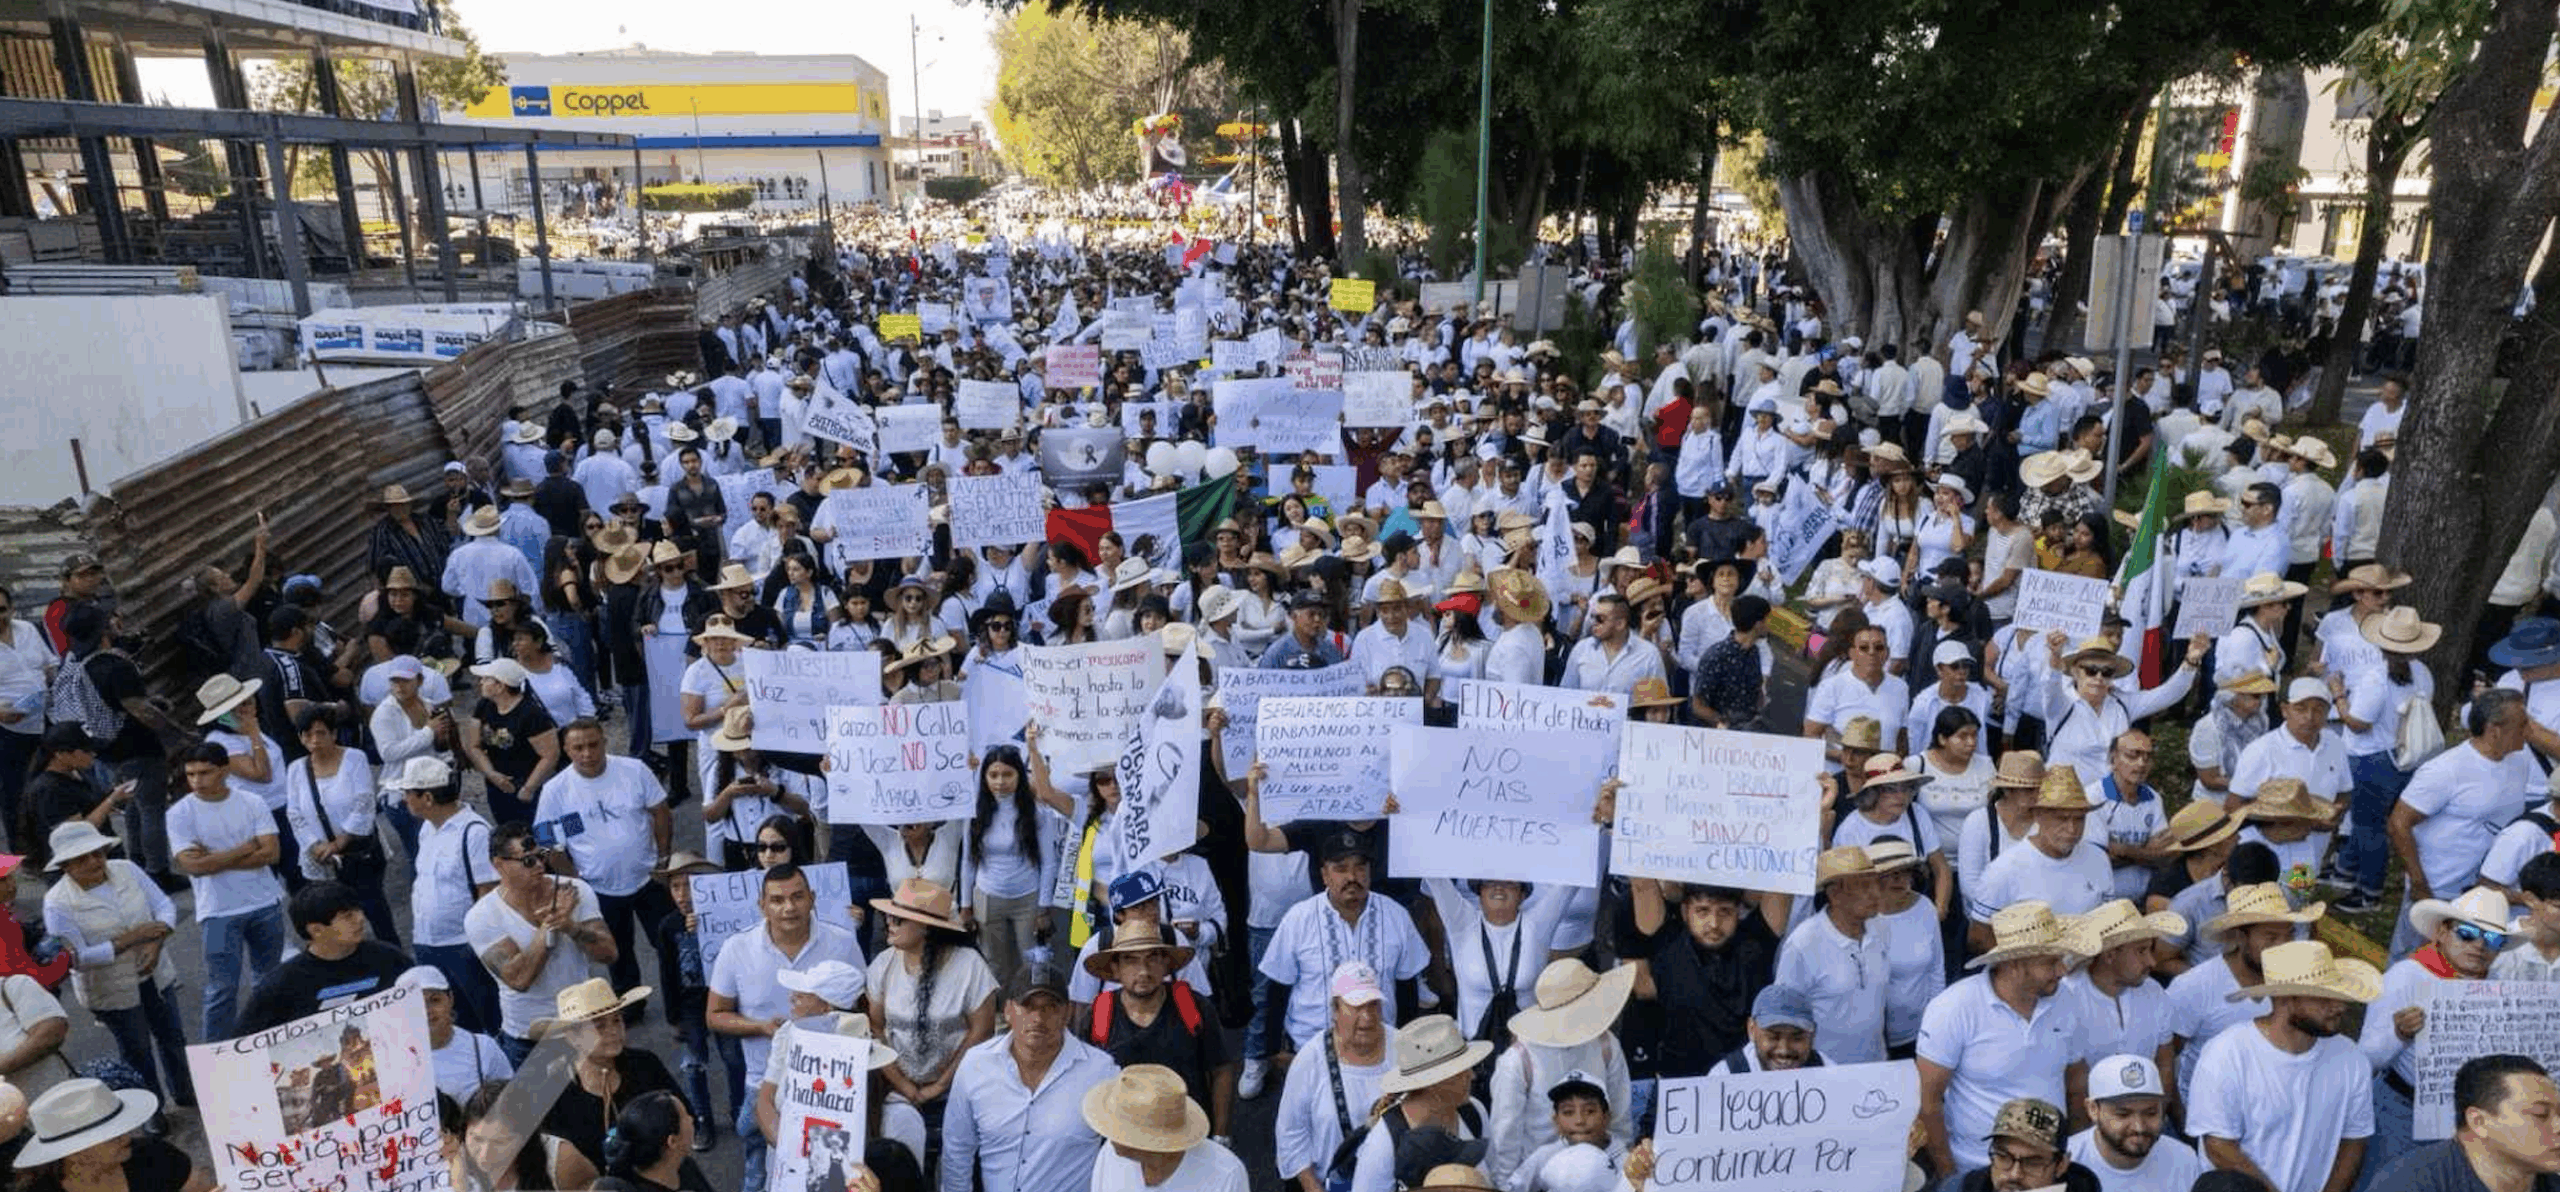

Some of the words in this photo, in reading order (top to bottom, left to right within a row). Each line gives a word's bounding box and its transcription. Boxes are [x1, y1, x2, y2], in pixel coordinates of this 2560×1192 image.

[563, 92, 650, 116] Coppel
[1086, 672, 1124, 694] hasta
[1131, 670, 1145, 691] la
[1246, 673, 1287, 688] BASTA
[1069, 696, 1088, 719] de
[1096, 695, 1110, 717] la
[1262, 702, 1350, 720] SEGUIREMOS
[1355, 701, 1377, 718] DE
[1383, 700, 1408, 718] PIE
[1460, 683, 1481, 718] El
[1486, 687, 1540, 722] Dolor
[881, 704, 909, 738] NO
[915, 704, 967, 738] Calla
[1260, 724, 1361, 742] TRABAJANDO
[859, 748, 899, 774] Voz
[902, 742, 926, 772] NO
[935, 742, 966, 772] Se
[1461, 745, 1523, 775] NO
[1456, 775, 1535, 803] MAS
[1434, 808, 1562, 847] MUERTES
[1689, 818, 1771, 846] MANZO
[692, 876, 717, 904] Si
[728, 874, 749, 902] El
[700, 911, 742, 934] Tiene
[233, 1020, 319, 1055] Carlos
[331, 989, 406, 1022] Manzo
[1664, 1086, 1699, 1135] El
[1719, 1079, 1827, 1132] legado
[358, 1097, 437, 1152] para
[1814, 1137, 1858, 1173] Por
